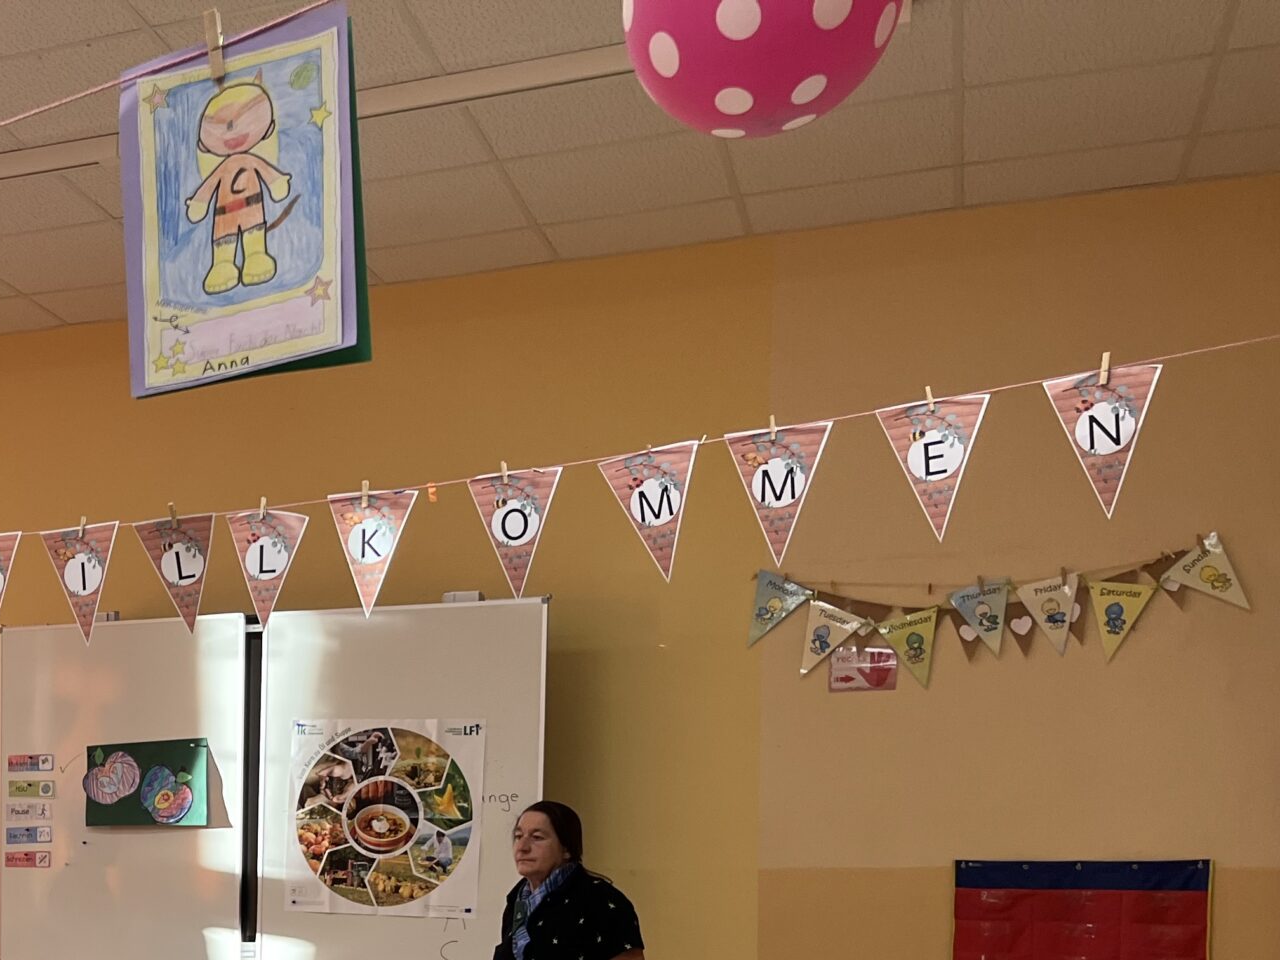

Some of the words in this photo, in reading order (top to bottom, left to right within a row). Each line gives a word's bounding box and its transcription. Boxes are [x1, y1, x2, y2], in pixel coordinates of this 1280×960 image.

[202, 356, 250, 375] Anna
[1033, 584, 1062, 597] Friday
[1099, 587, 1143, 600] Saturday
[818, 608, 852, 627] Tuesday
